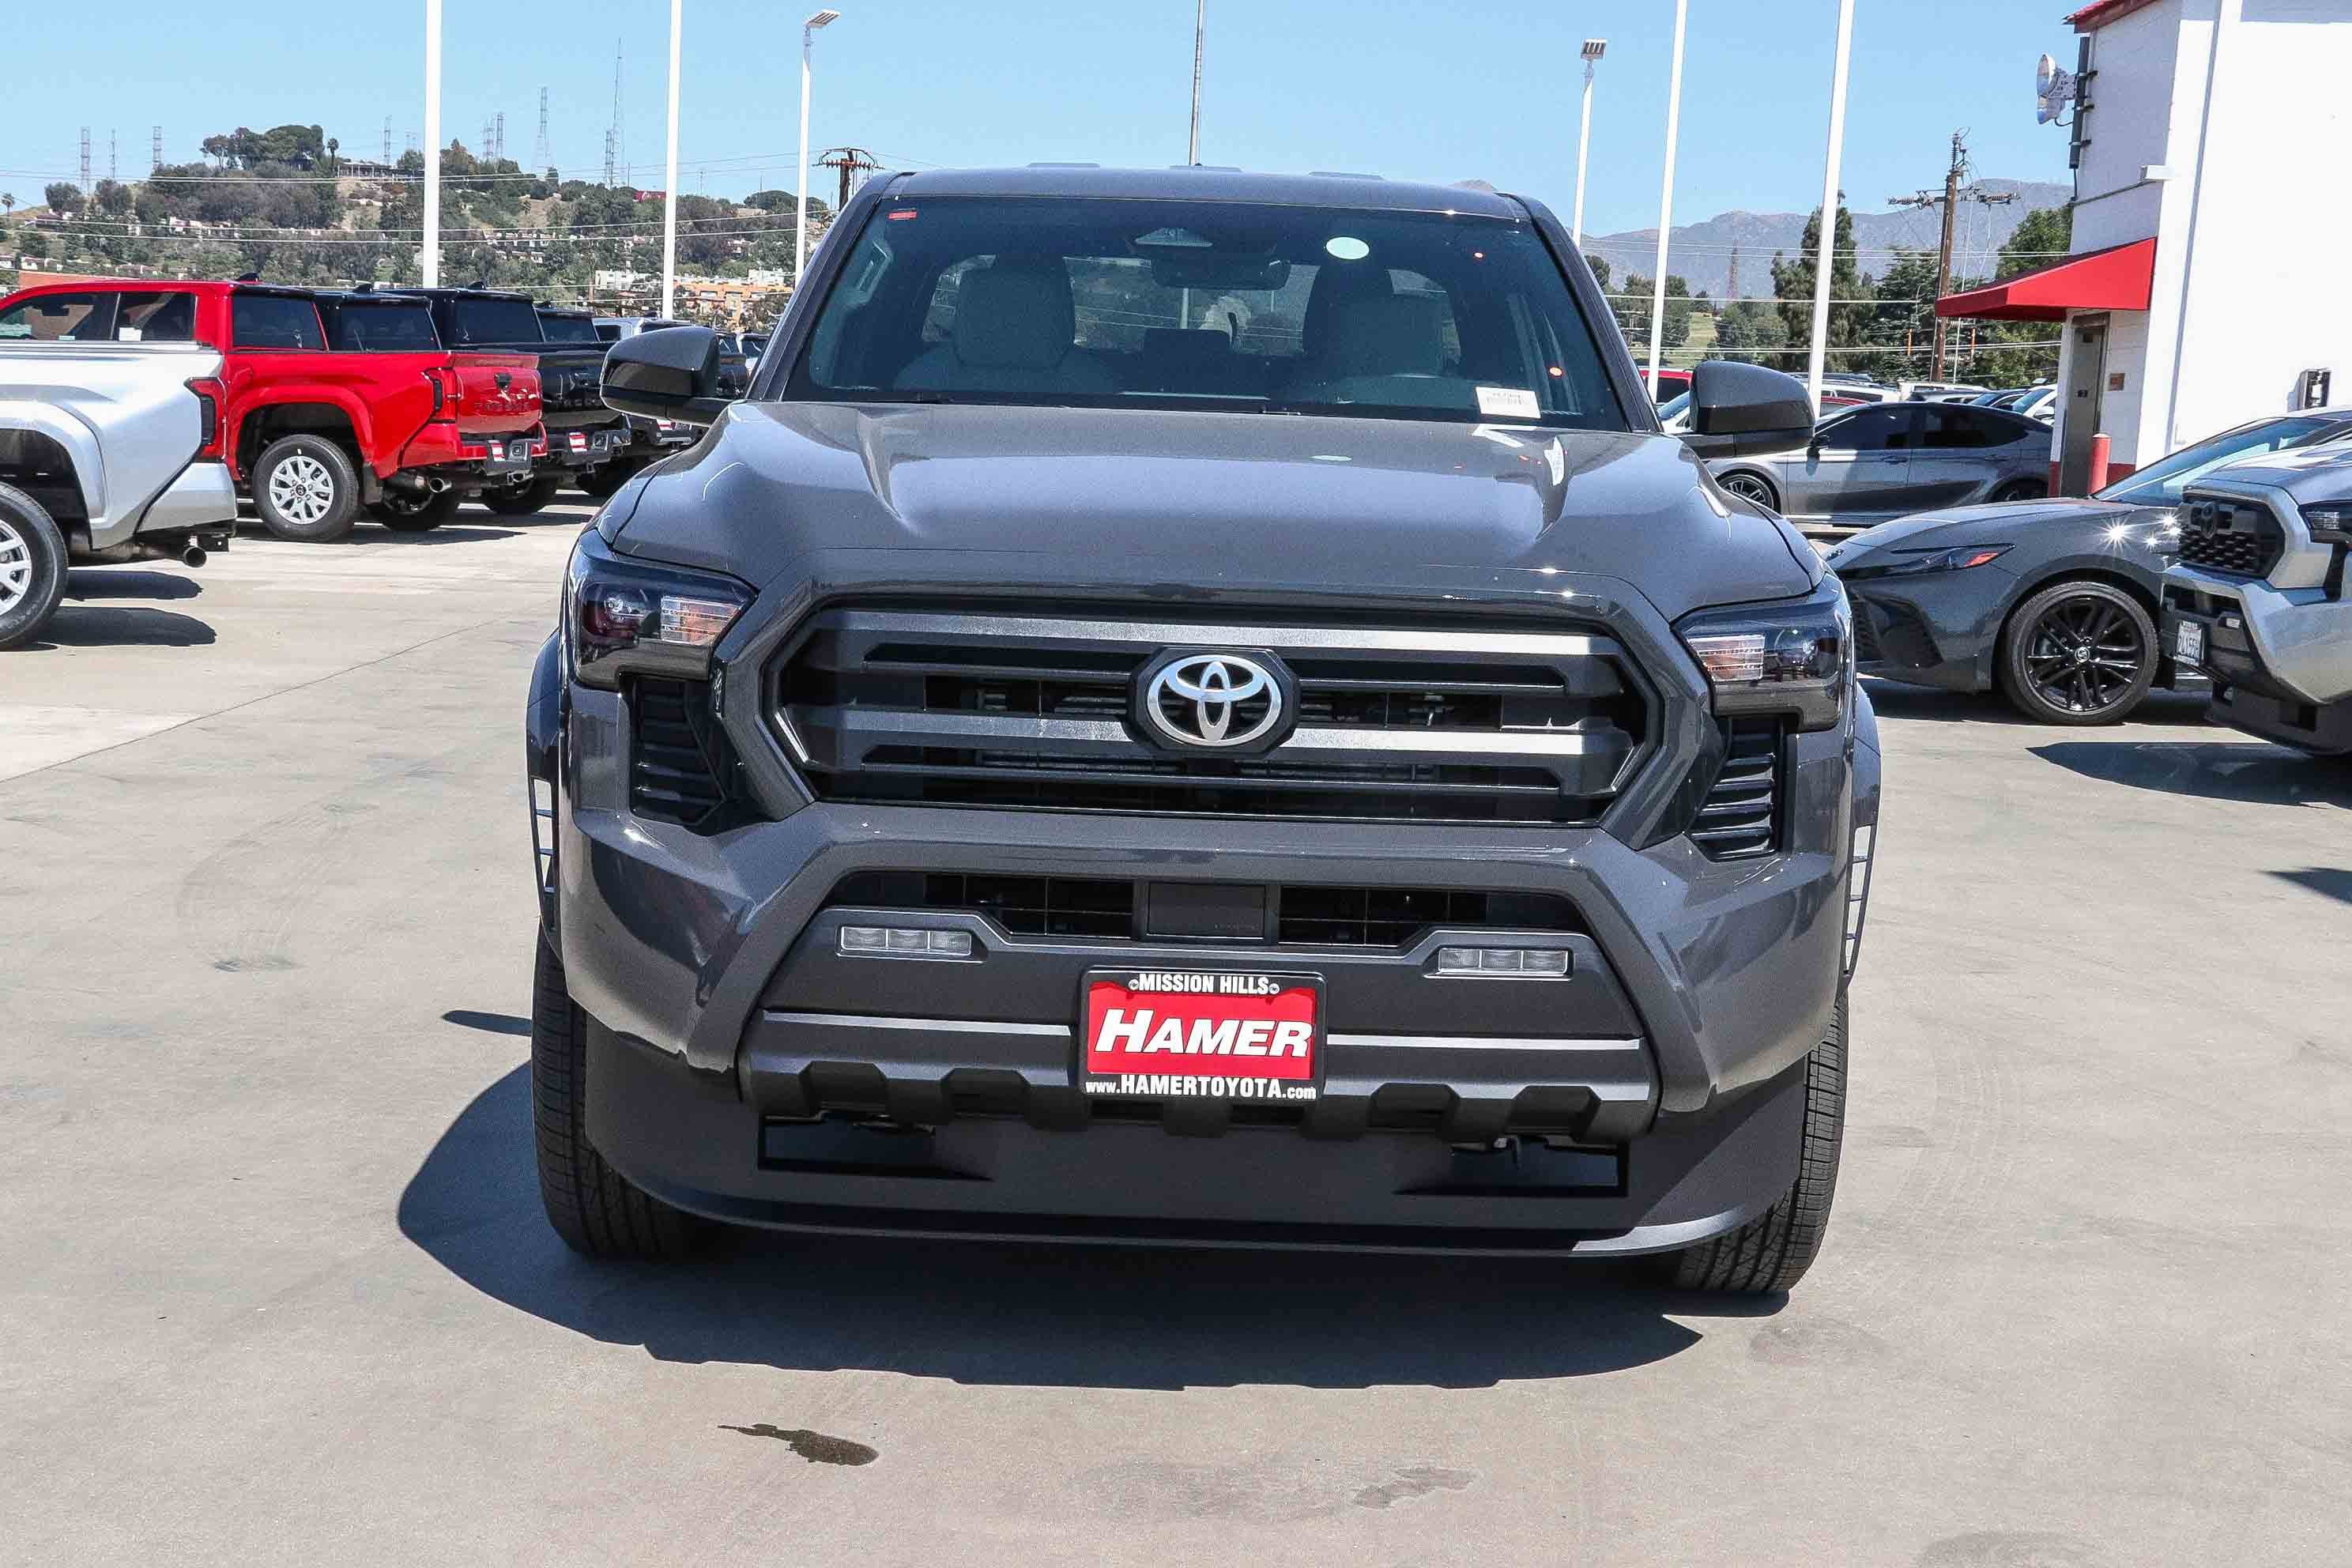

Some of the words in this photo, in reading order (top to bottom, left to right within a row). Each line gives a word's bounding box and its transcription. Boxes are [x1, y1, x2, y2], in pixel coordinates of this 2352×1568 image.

[1139, 973, 1214, 993] MISSION
[1219, 975, 1269, 995] HILLS
[1094, 1008, 1314, 1057] HAMER
[1085, 1074, 1317, 1100] www.HAMERTOYOTA.com
